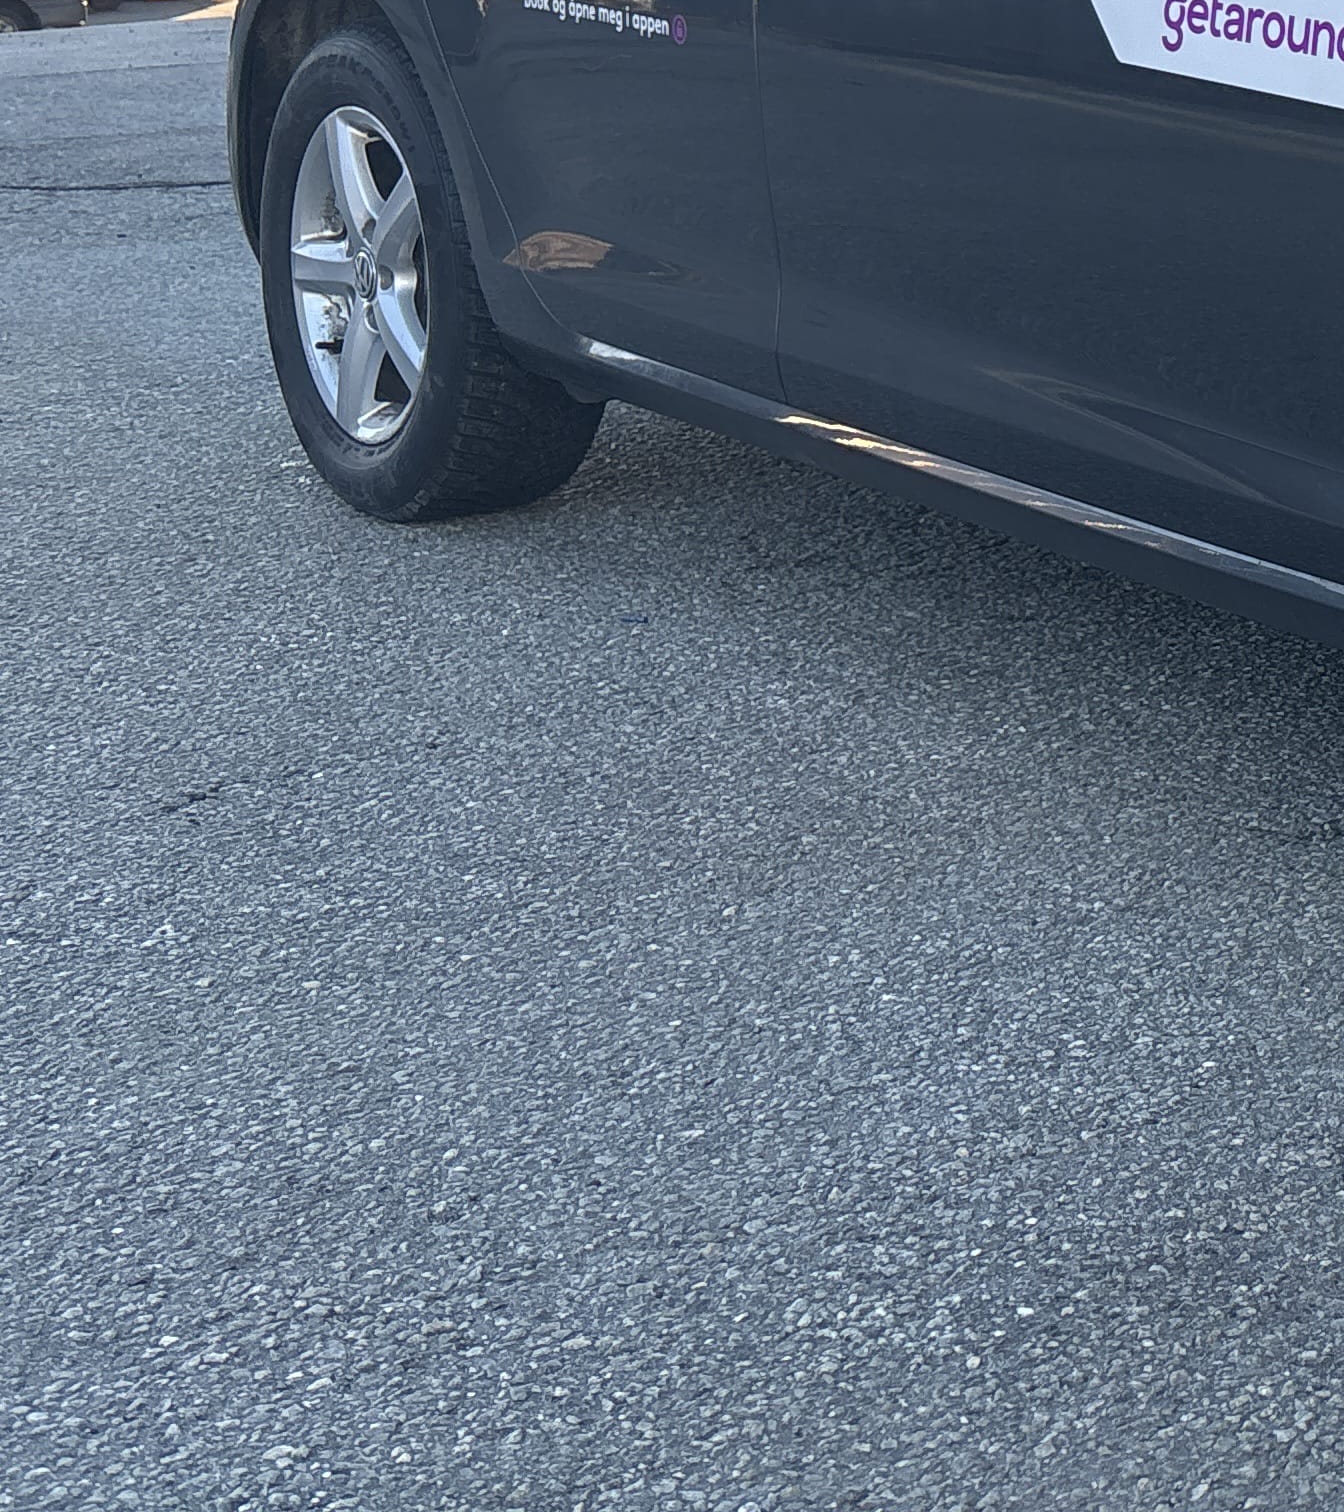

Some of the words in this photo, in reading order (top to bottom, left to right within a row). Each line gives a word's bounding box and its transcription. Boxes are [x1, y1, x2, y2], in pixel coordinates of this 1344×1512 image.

[552, 0, 566, 20] og
[599, 7, 623, 32] meg
[625, 6, 630, 26] i
[632, 15, 670, 38] appen
